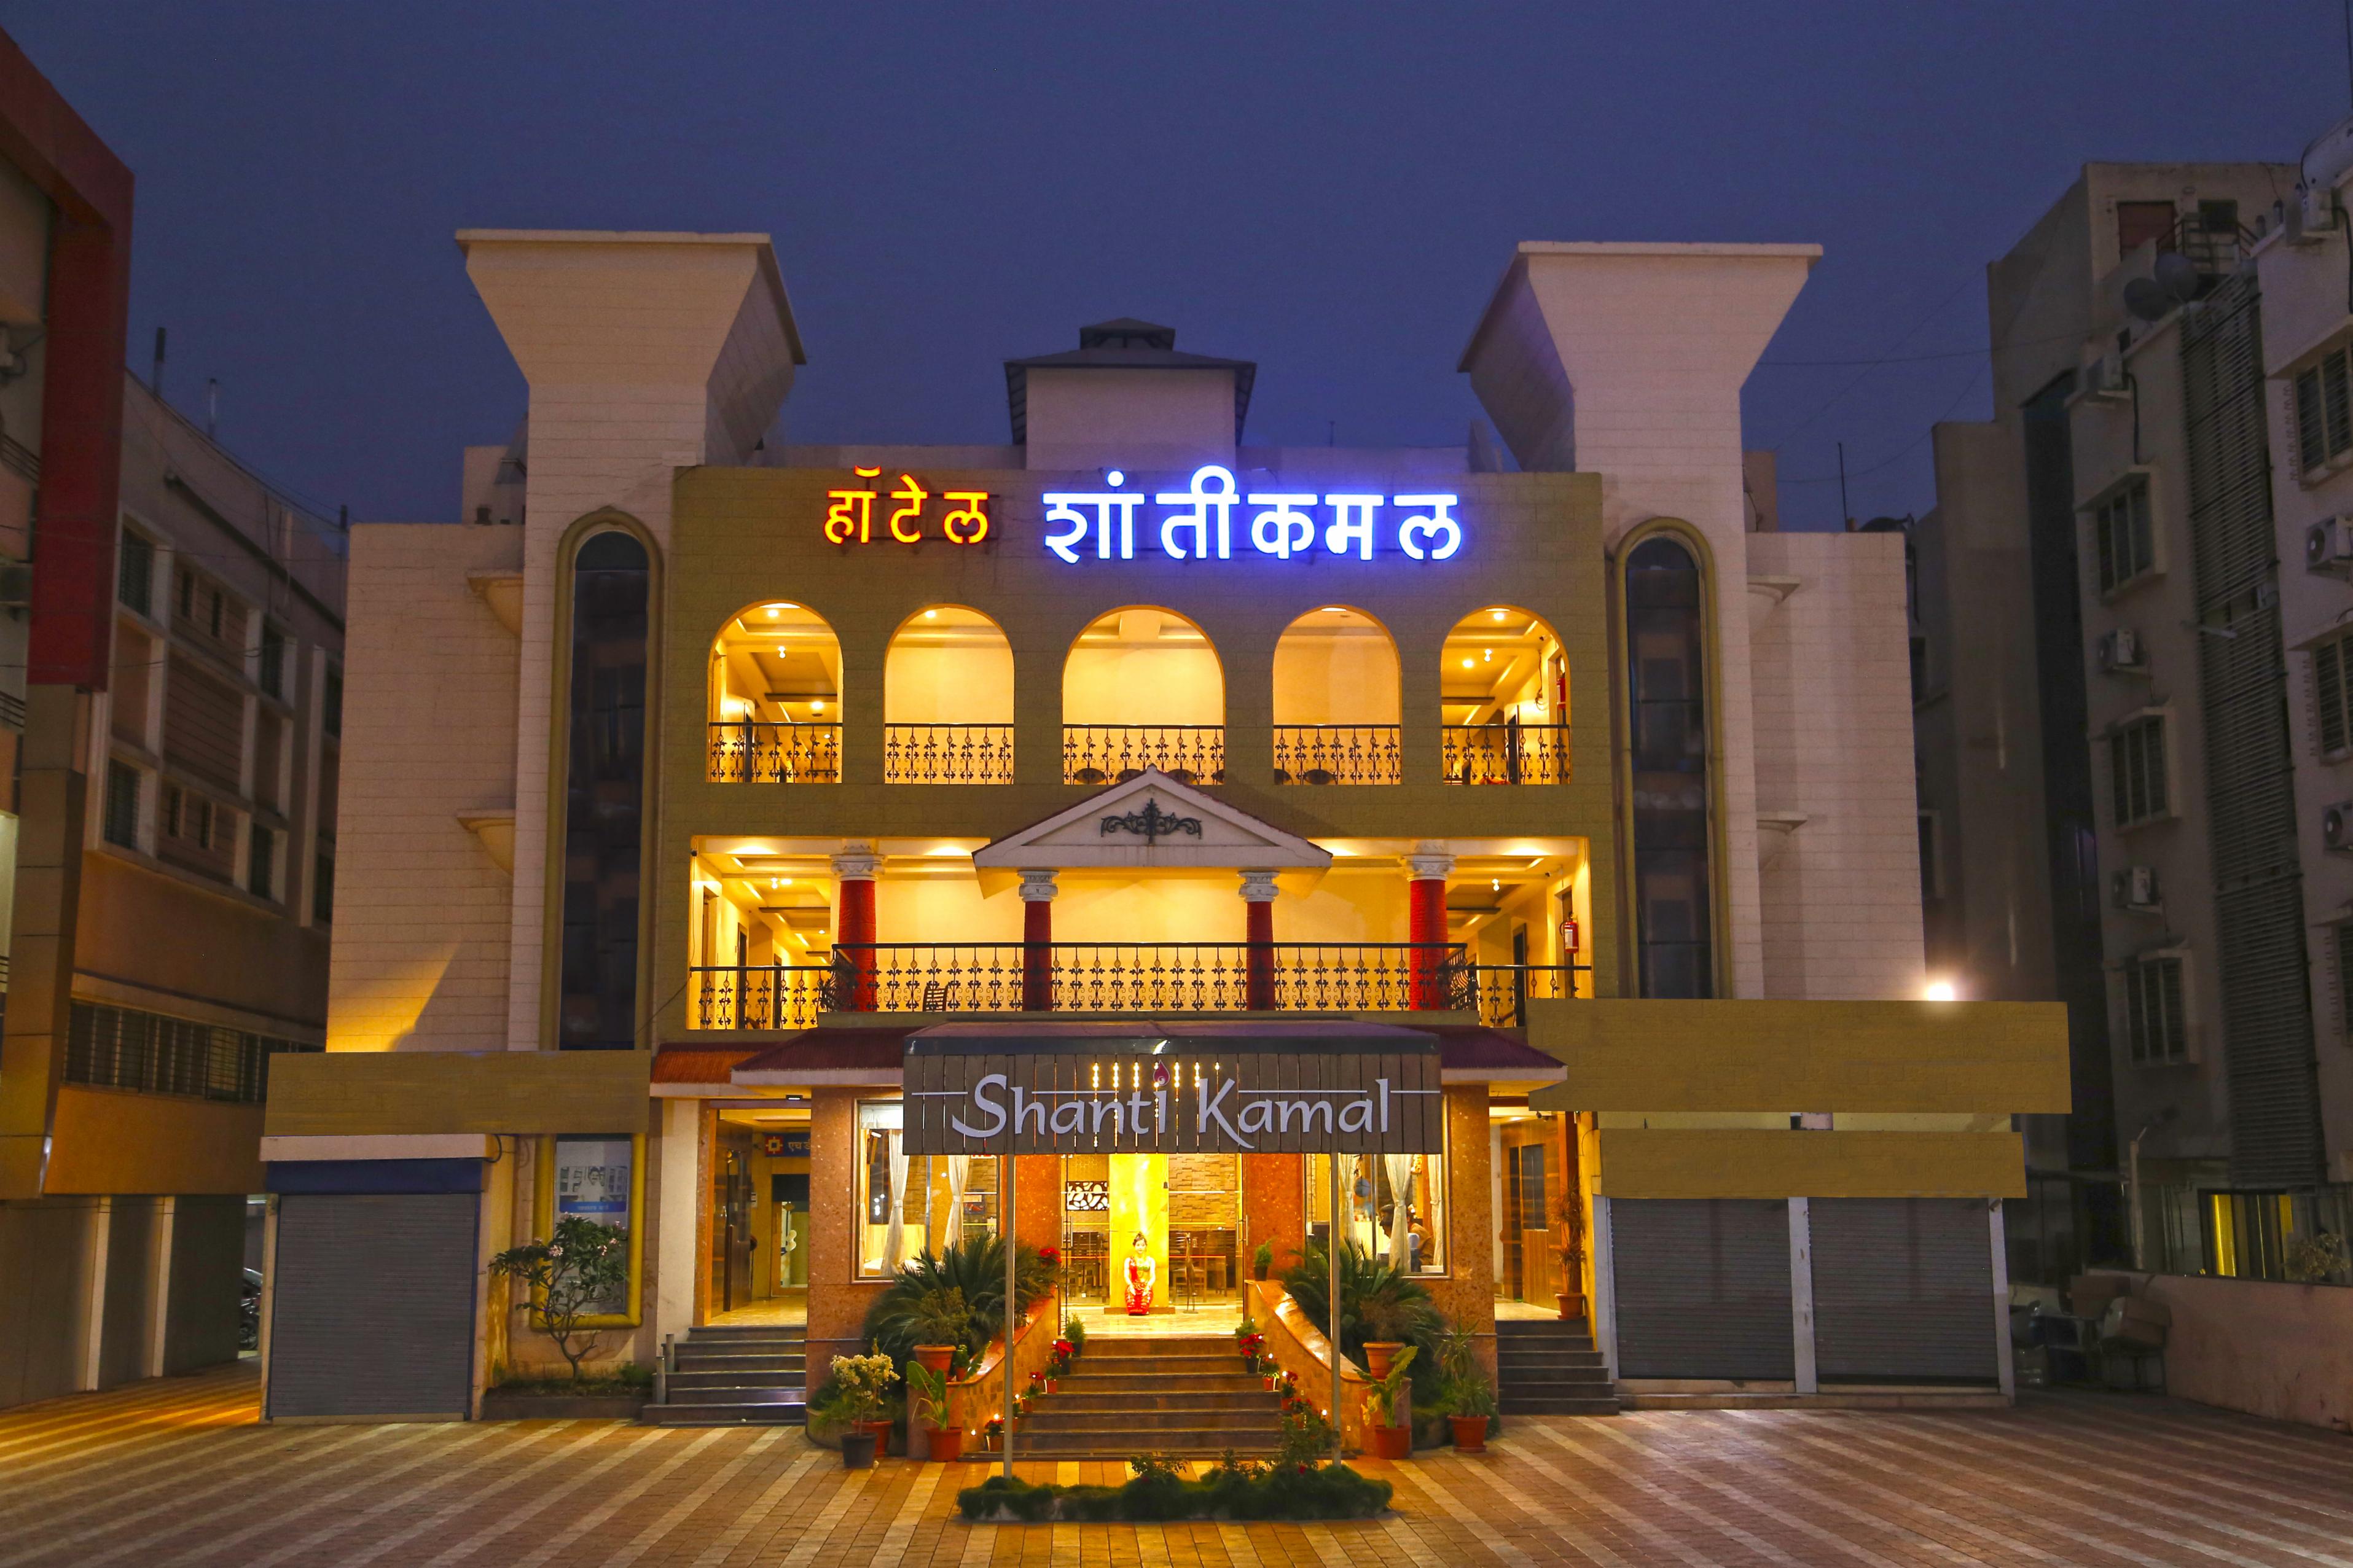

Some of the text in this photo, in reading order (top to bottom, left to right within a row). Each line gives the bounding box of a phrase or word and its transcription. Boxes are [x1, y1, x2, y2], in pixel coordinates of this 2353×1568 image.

[824, 465, 989, 544] हॉटेल
[952, 1074, 1388, 1149] Shanti Kamal
